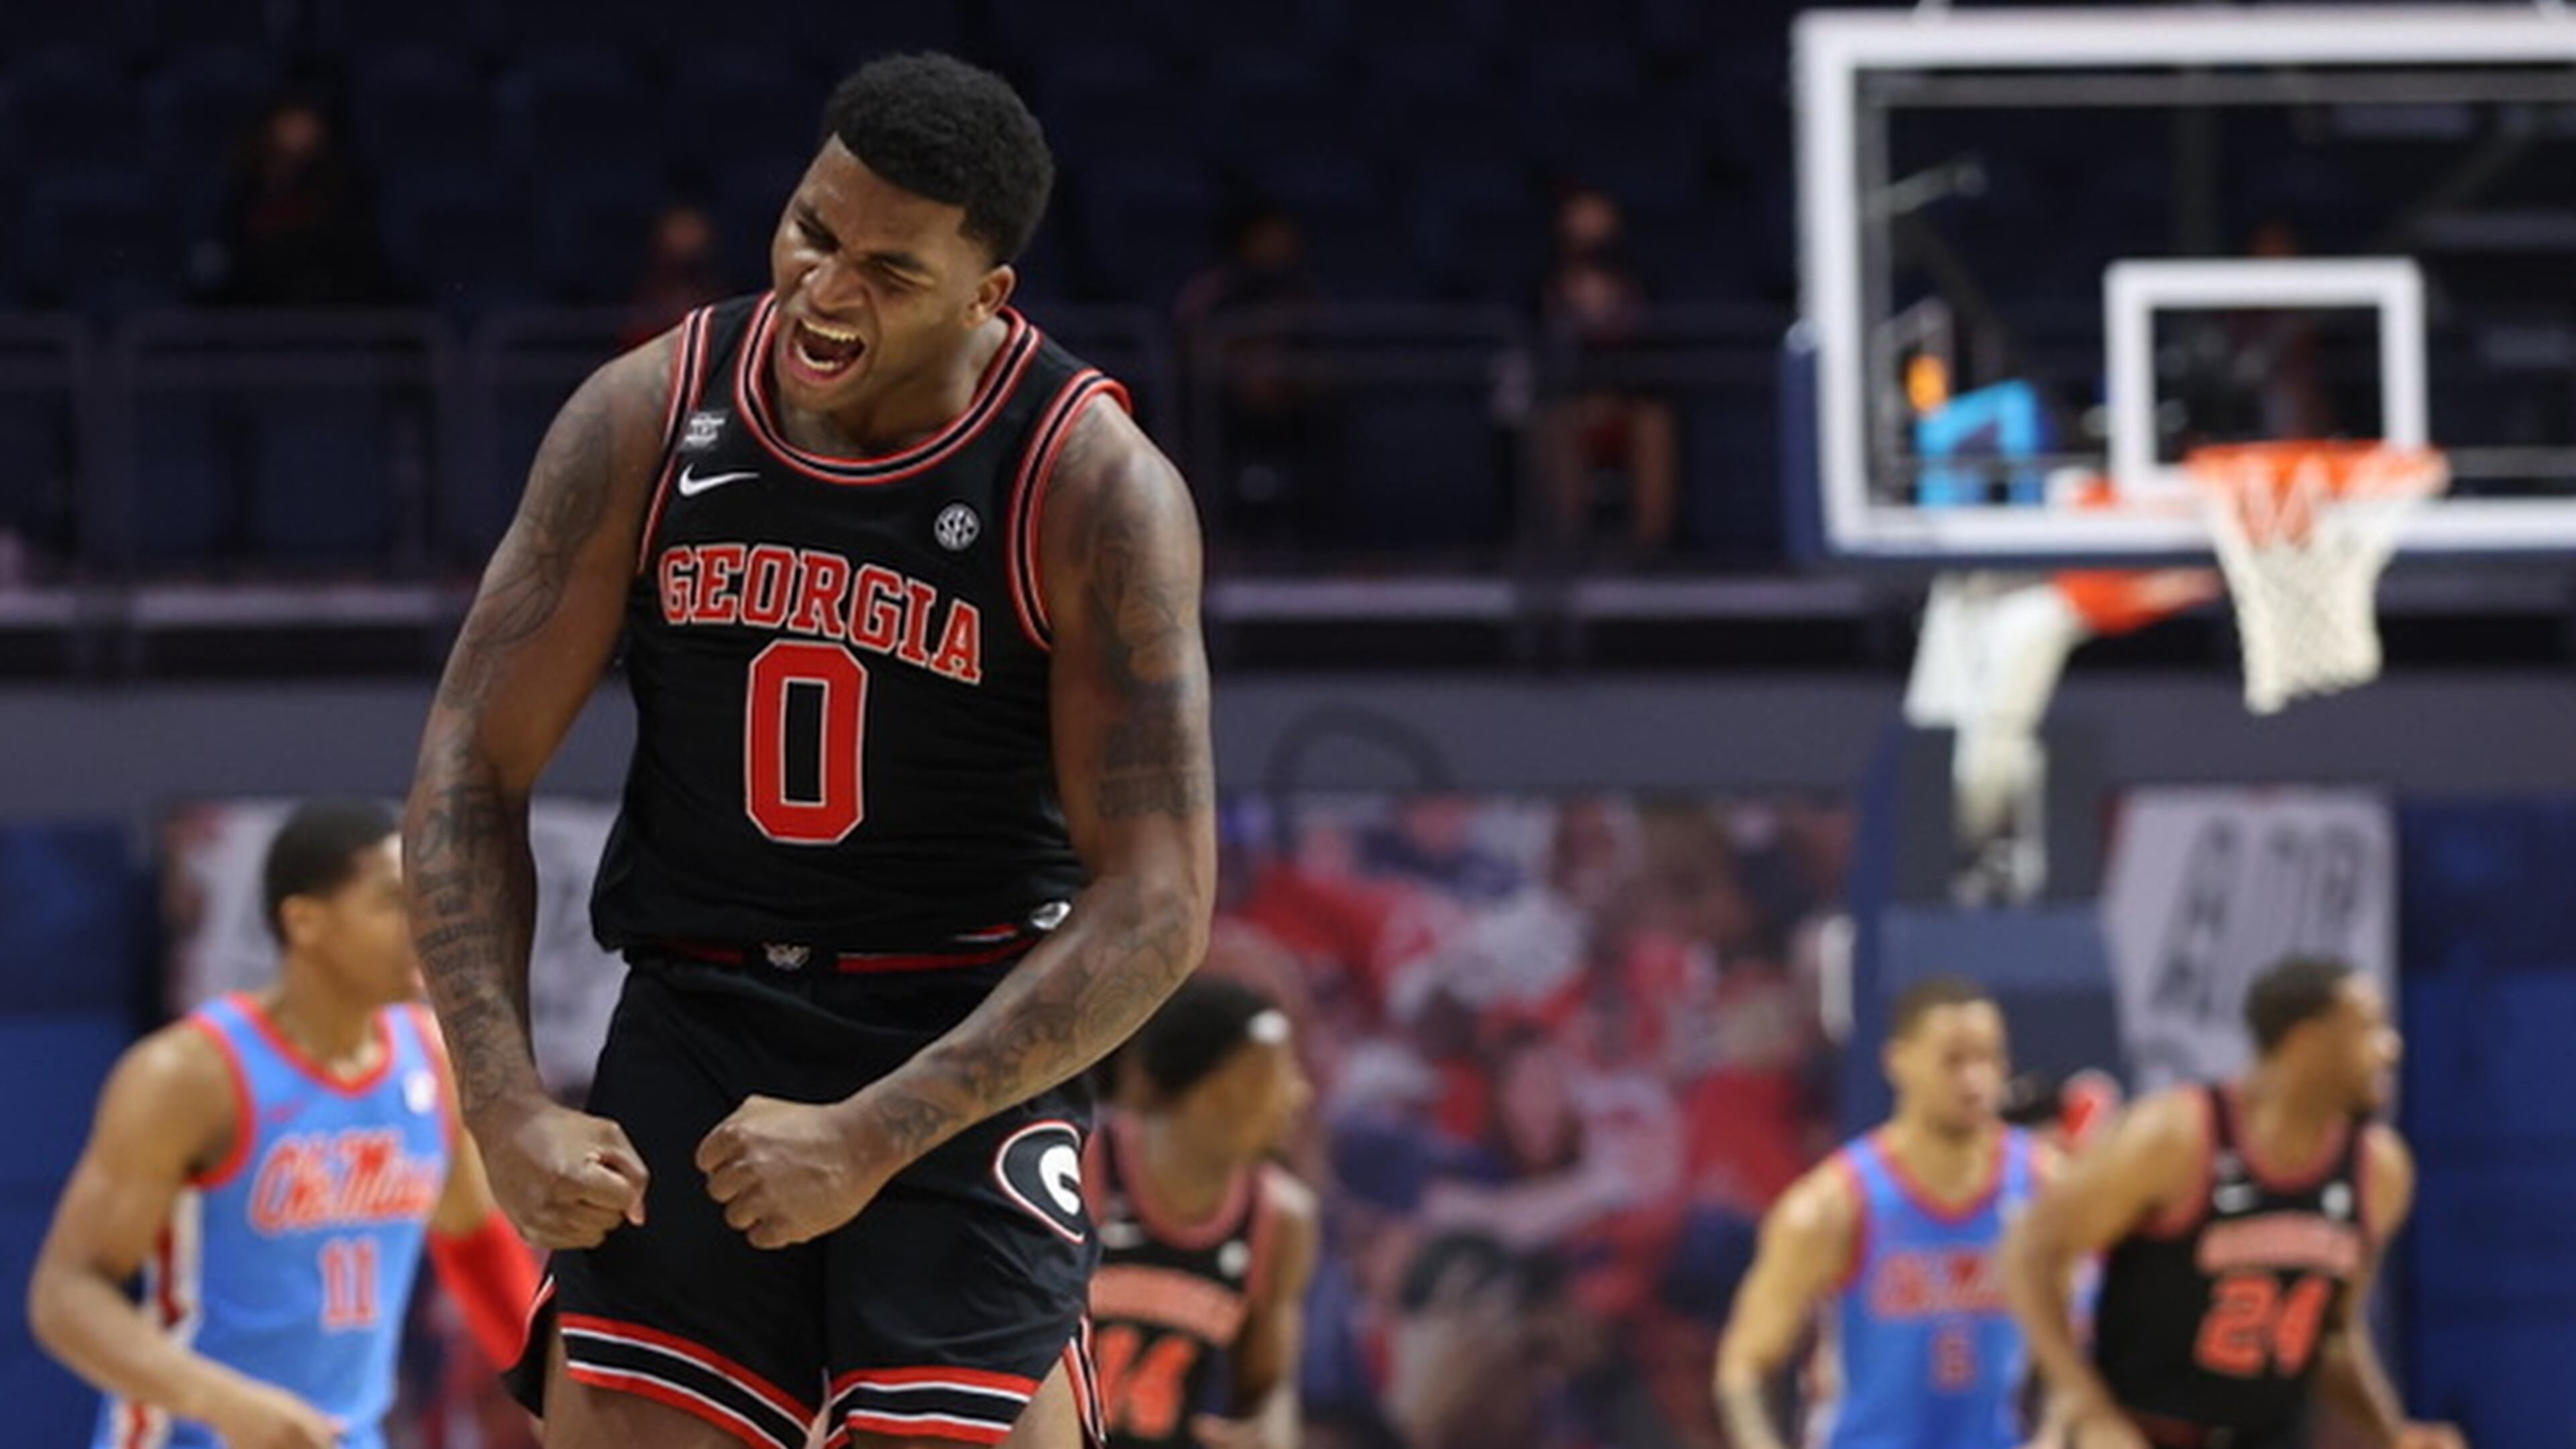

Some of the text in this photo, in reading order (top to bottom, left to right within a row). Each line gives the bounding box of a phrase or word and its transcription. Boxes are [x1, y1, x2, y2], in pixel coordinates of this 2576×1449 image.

[658, 543, 981, 684] GEORGIA
[745, 639, 868, 844] 0
[319, 1236, 380, 1334] 11
[2194, 1272, 2332, 1379] 24
